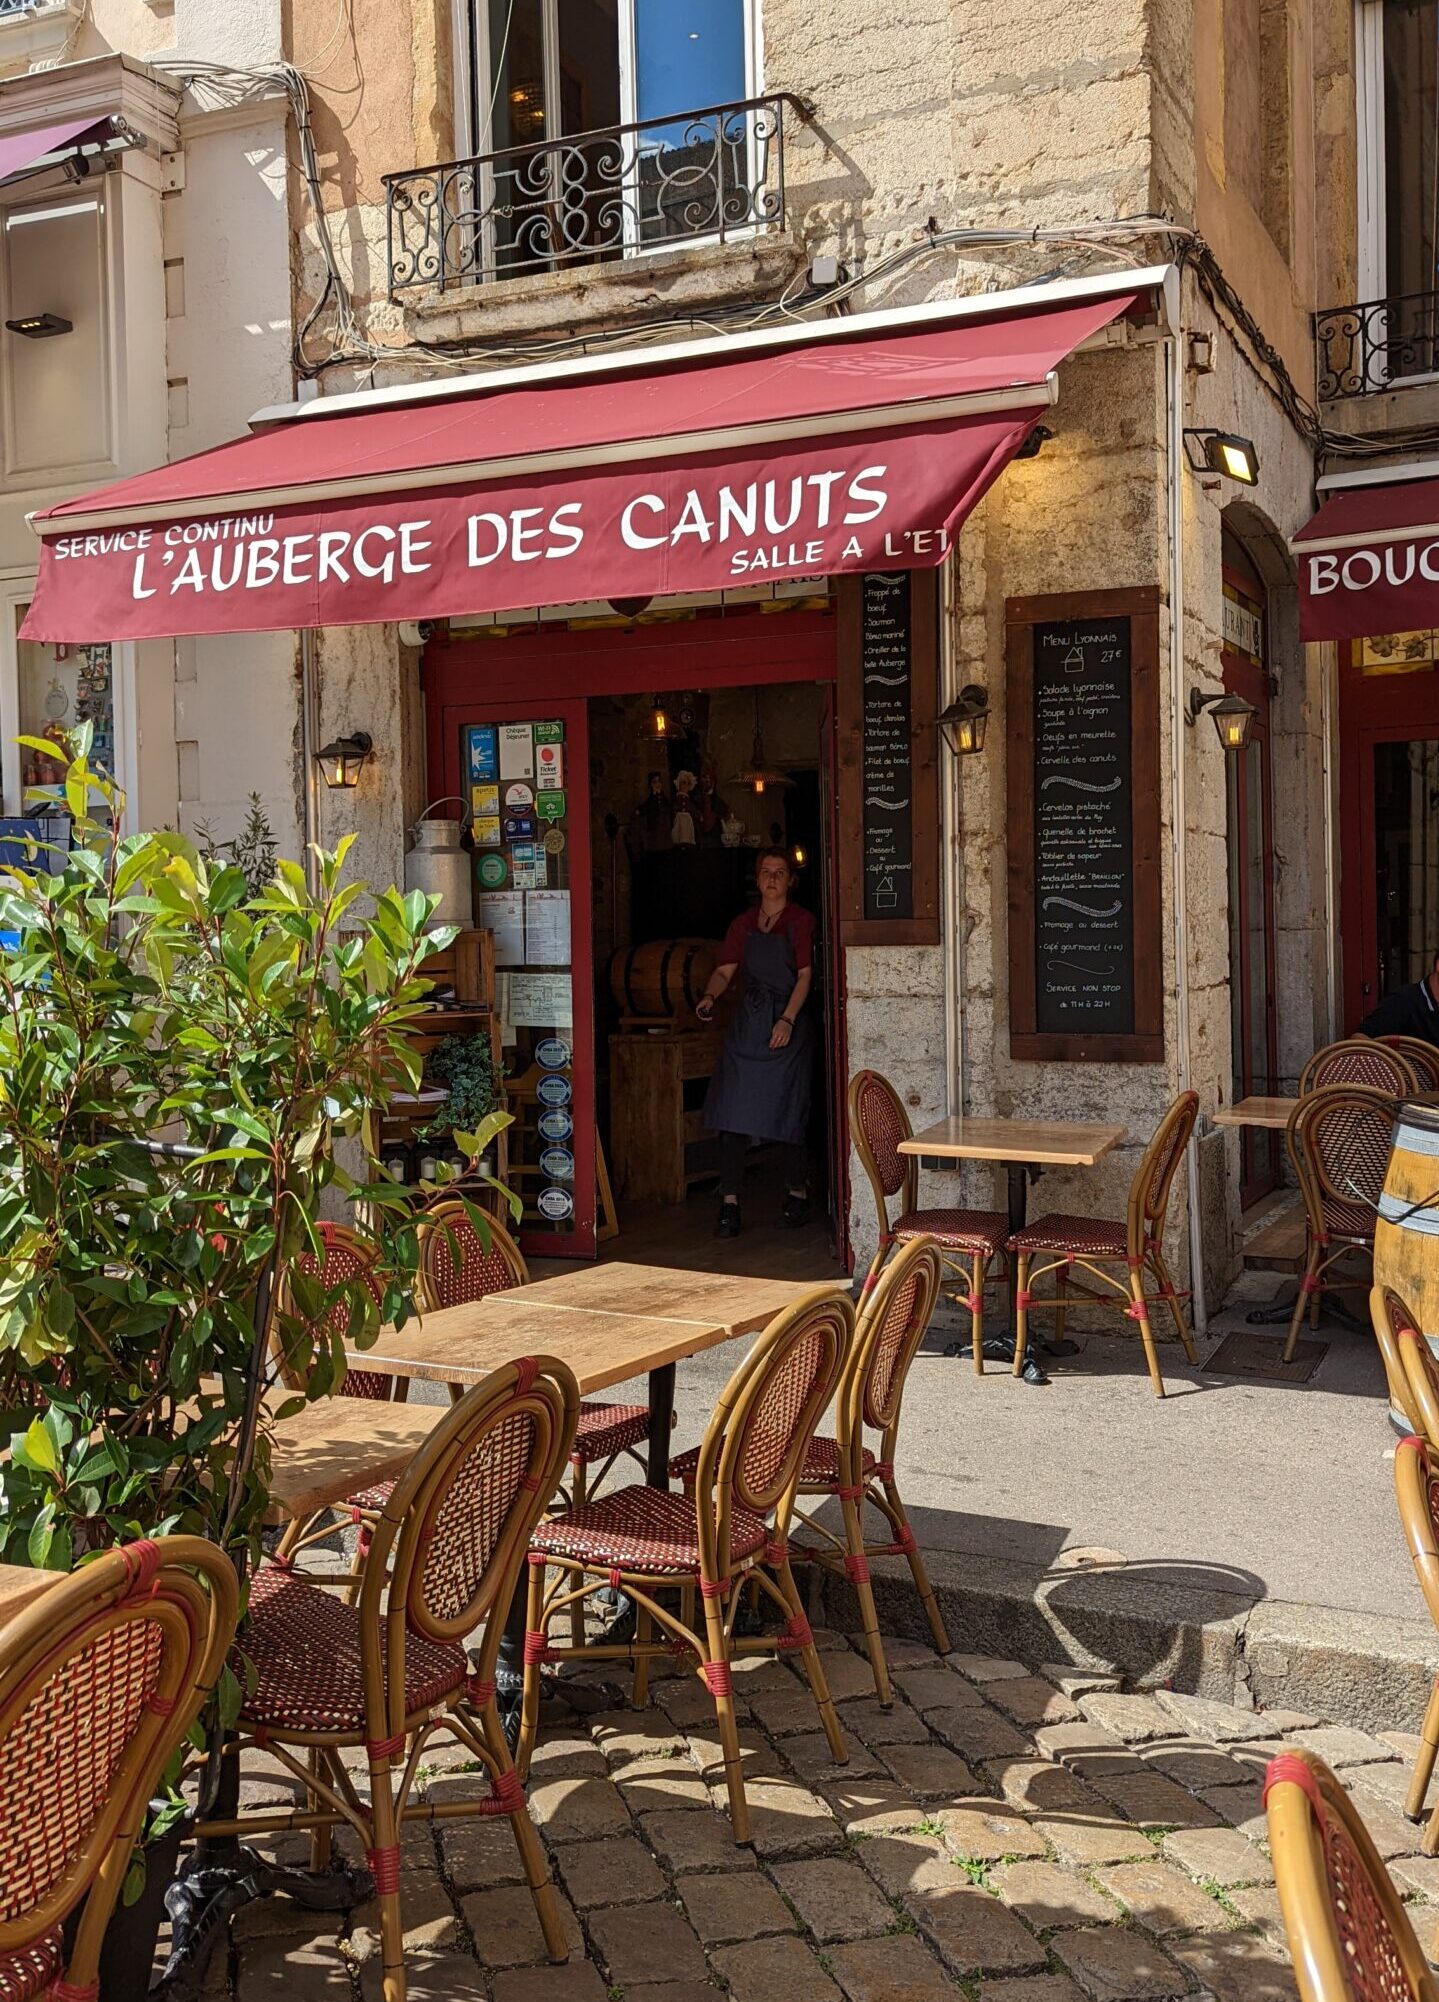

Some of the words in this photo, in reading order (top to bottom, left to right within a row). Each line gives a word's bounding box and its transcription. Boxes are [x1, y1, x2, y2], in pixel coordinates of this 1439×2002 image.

[55, 529, 152, 560] SERVICE
[164, 513, 274, 546] CONTINU
[133, 520, 432, 600] L'AUBERGE
[467, 502, 584, 568] DES
[620, 465, 888, 550] CANUTS
[731, 540, 825, 575] SALLE
[842, 536, 864, 560] A
[1043, 634, 1070, 648] MENU
[879, 659, 906, 670] Auberge
[1043, 683, 1070, 695] Salade
[1073, 681, 1115, 697] lyonnaise
[1042, 709, 1066, 721] Soupe
[1068, 707, 1074, 715] à
[1077, 706, 1109, 720] l'oignon
[1042, 732, 1065, 744] Oeufs
[1080, 730, 1117, 739] meurette
[1041, 755, 1071, 765] Cervelle
[1072, 755, 1086, 763] des
[1089, 752, 1117, 763] canuts
[1042, 802, 1074, 811] Cervelas
[1076, 801, 1112, 815] pistaché
[1042, 827, 1073, 840] Quenelle
[1077, 827, 1086, 835] de
[1088, 826, 1117, 835] brochet
[869, 845, 896, 854] Dessert
[1041, 852, 1064, 861] Tablier
[1067, 852, 1075, 860] de
[1077, 852, 1102, 864] sapeur
[869, 863, 884, 875] Café
[1041, 872, 1086, 882] Andouillette
[1044, 921, 1073, 932] Fromage
[1090, 920, 1119, 929] dessert
[1043, 942, 1059, 953] Café
[1061, 943, 1100, 954] gourmand
[1046, 981, 1077, 992] SERVICE
